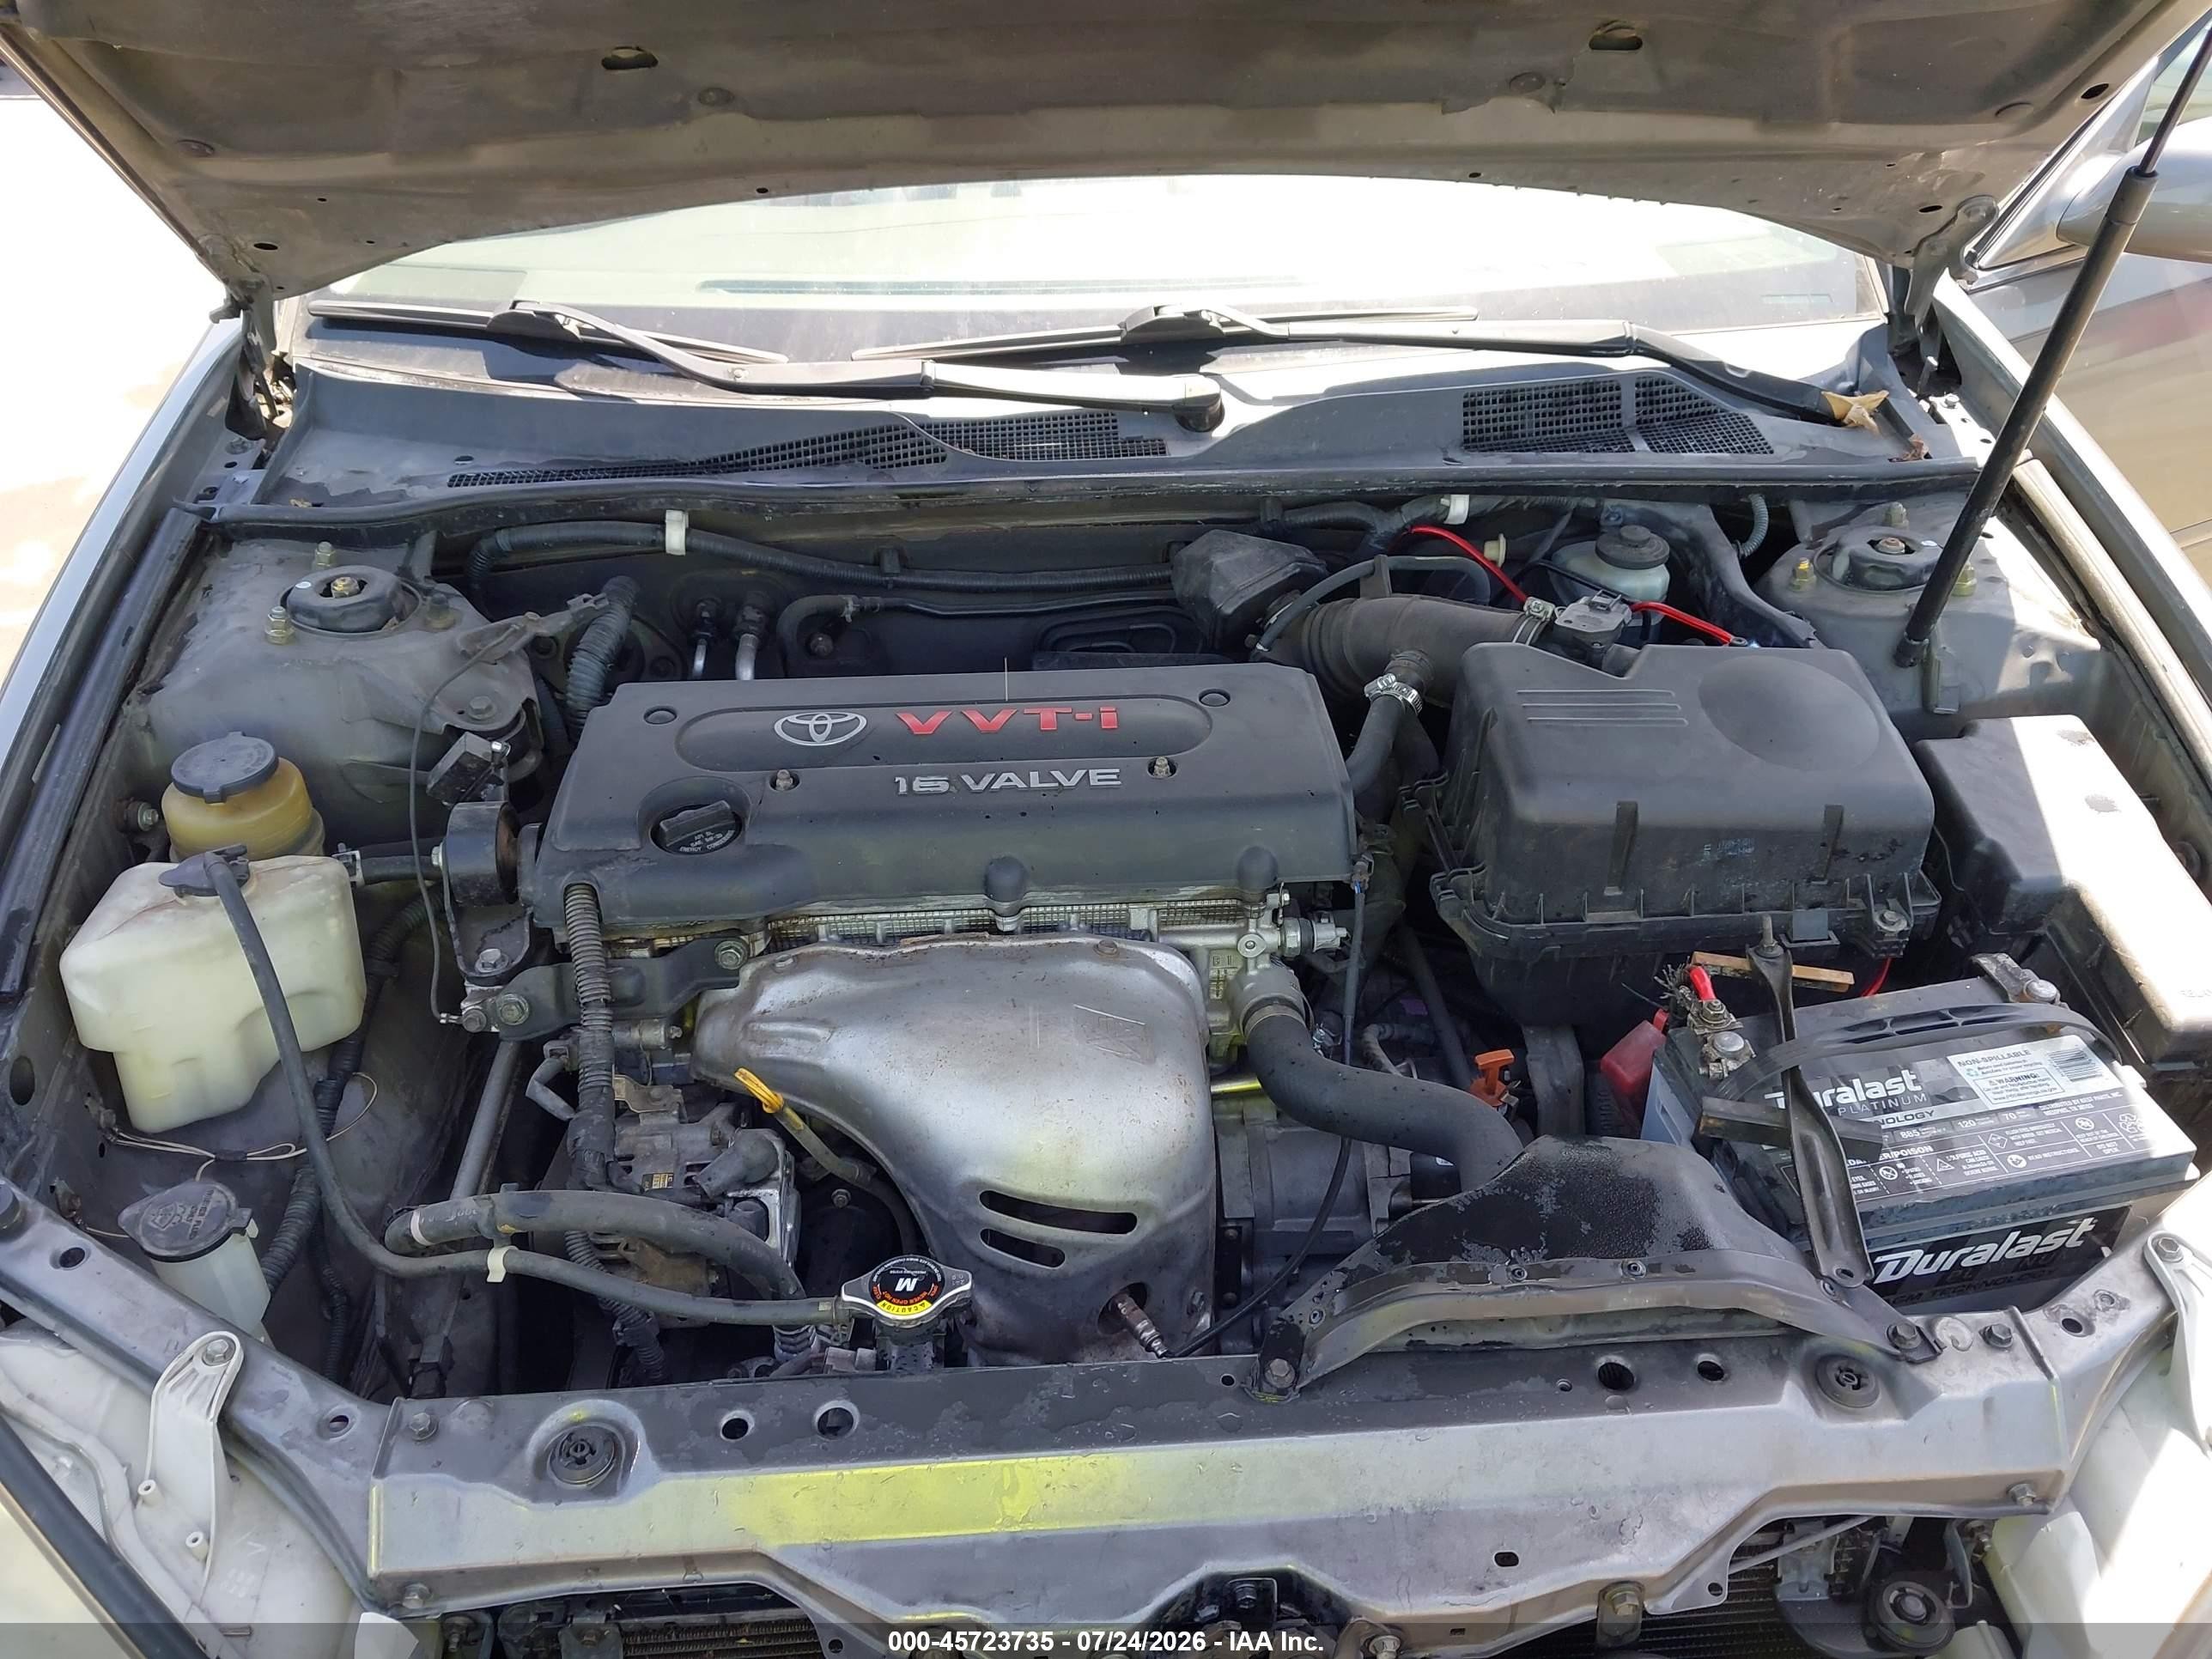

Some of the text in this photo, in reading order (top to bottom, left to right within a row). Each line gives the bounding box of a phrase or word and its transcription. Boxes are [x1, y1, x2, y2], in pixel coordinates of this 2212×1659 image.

[895, 707, 1118, 735] VVT-i
[895, 769, 1122, 796] 16 VALVE
[1957, 1049, 2032, 1066] NON-SPILLABLE
[1764, 1069, 1923, 1110] ralast
[1838, 1092, 1927, 1116] PLATINUM
[1874, 1109, 1935, 1125] NOLOGY
[1958, 1119, 1977, 1128] 120
[2004, 1112, 2017, 1121] 70
[1900, 1129, 1920, 1139] 885
[1846, 1145, 1934, 1167] DAER/POISON
[1873, 1217, 2099, 1285] Duralast
[895, 1278, 918, 1291] M
[880, 1302, 918, 1313] CAUTION
